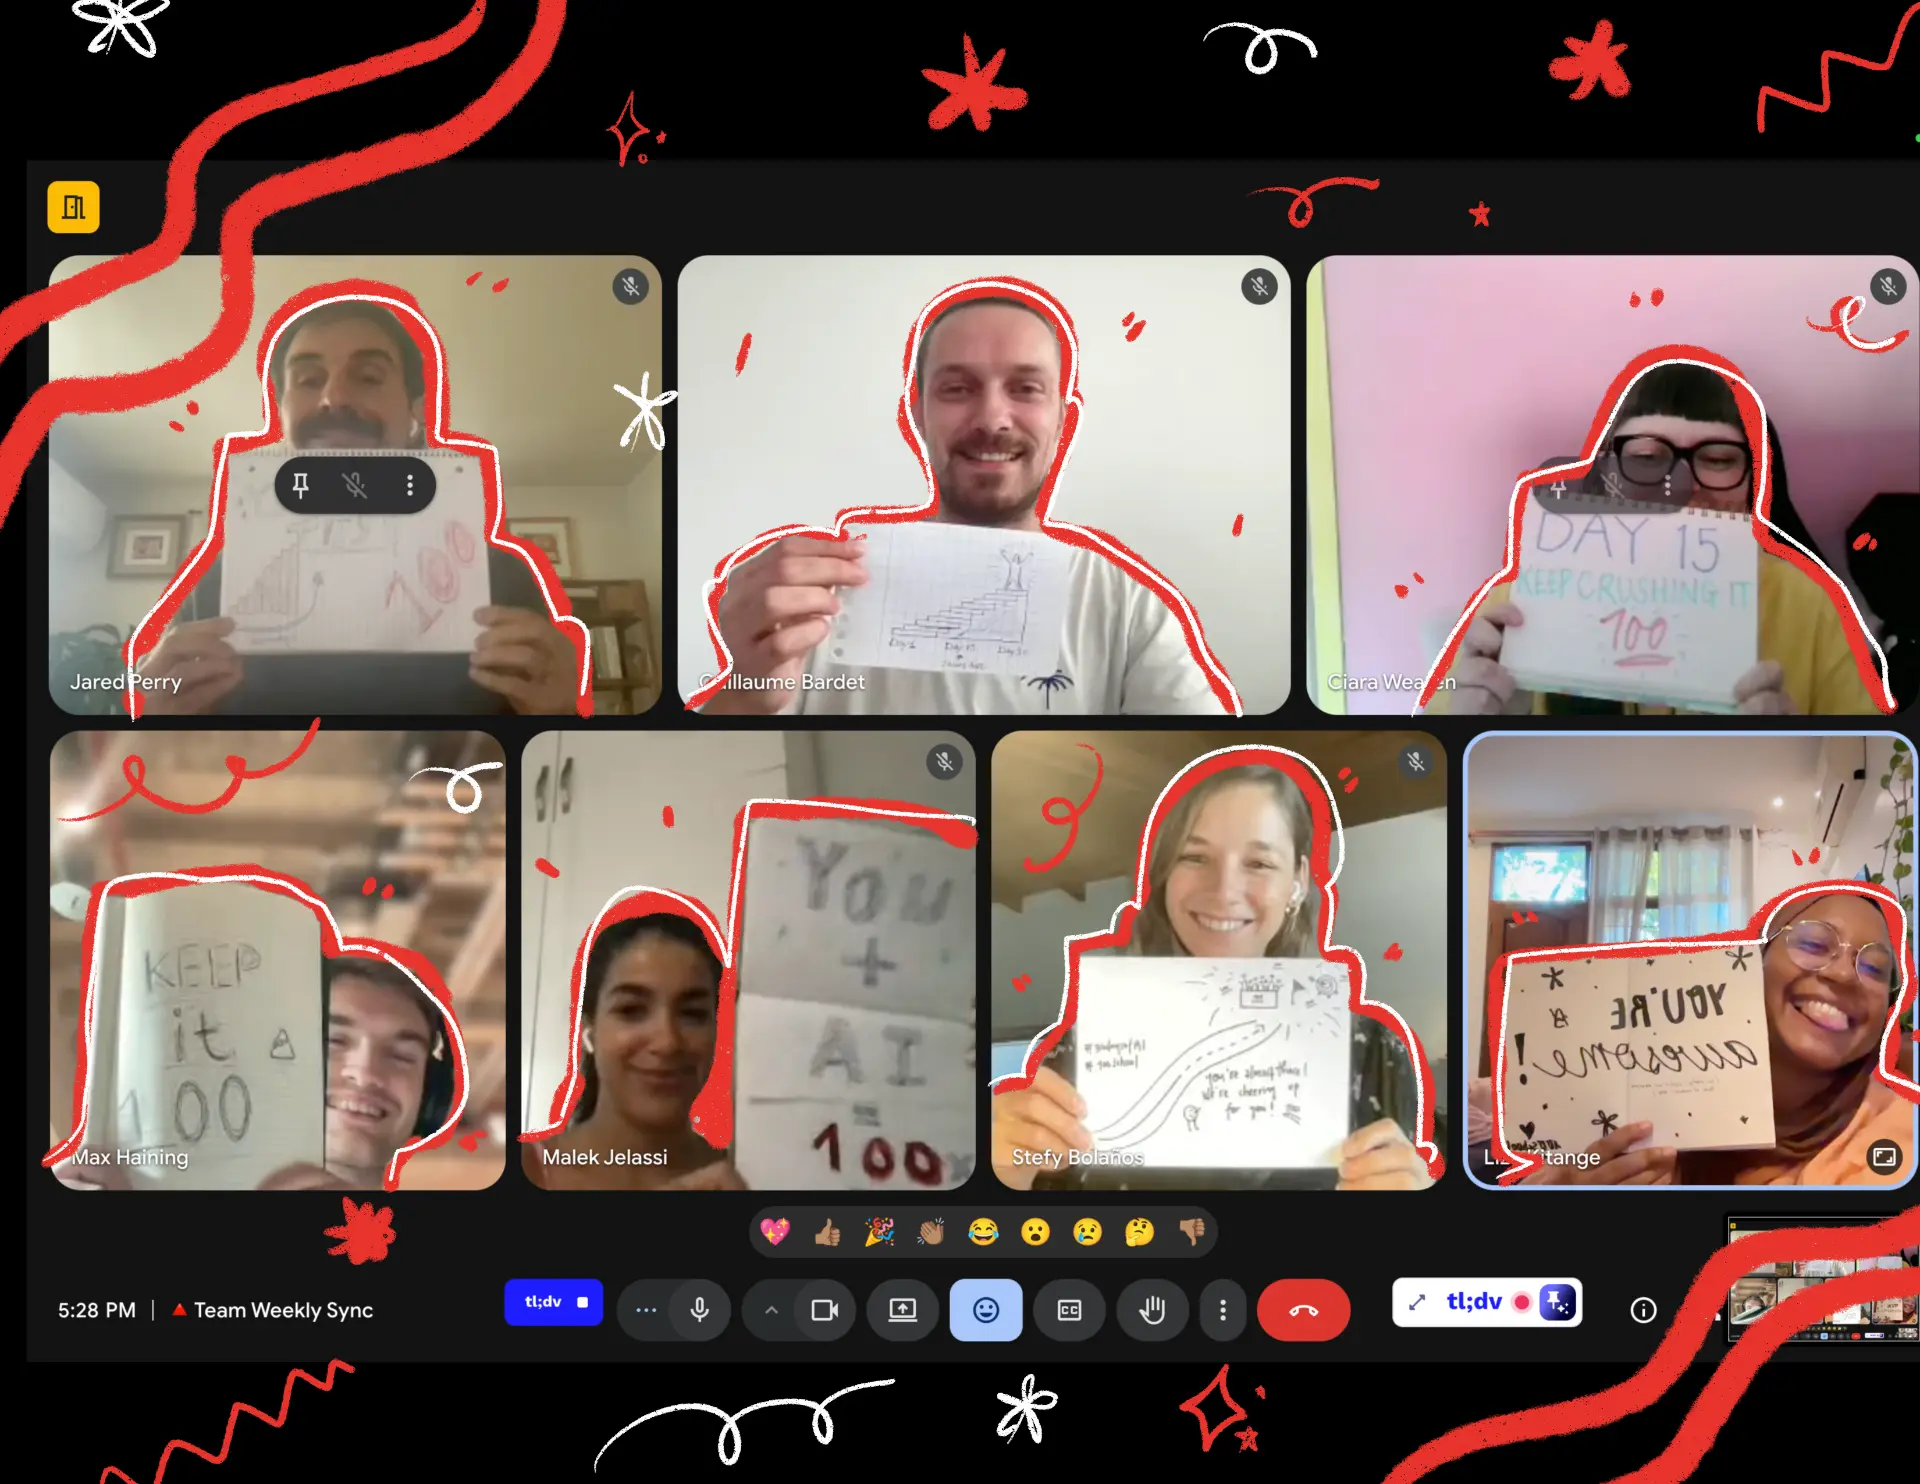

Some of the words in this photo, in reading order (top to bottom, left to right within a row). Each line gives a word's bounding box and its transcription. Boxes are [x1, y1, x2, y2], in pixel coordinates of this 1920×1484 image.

[1536, 511, 1649, 564] DAY
[1676, 524, 1720, 573] 15
[1517, 564, 1574, 598] KEEP
[1576, 567, 1719, 609] CRUSHING
[1729, 580, 1753, 609] IT
[1600, 607, 1668, 652] 100
[70, 673, 125, 690] Jared
[128, 673, 183, 694] Perry
[802, 673, 866, 690] Bardet
[1328, 673, 1378, 690] Ciara
[1383, 673, 1456, 690] Weaen
[143, 942, 262, 992] KEEP
[170, 1006, 234, 1063] it
[809, 1015, 928, 1087] AI
[1238, 1083, 1276, 1101] cheering
[116, 1074, 252, 1142] 100
[1225, 1102, 1240, 1121] for
[72, 1149, 111, 1165] Max
[117, 1149, 188, 1169] Haining
[543, 1149, 599, 1165] Malek
[604, 1149, 667, 1165] Jelassi
[1013, 1149, 1063, 1169] Stefy
[1069, 1149, 1144, 1165] Bolaños
[58, 1301, 99, 1319] 5:28
[106, 1301, 136, 1318] PM
[194, 1301, 246, 1318] Team
[251, 1301, 322, 1323] Weekly
[326, 1301, 374, 1323] Sync
[525, 1294, 562, 1310] tl;dv
[1446, 1291, 1503, 1312] tl;dv
